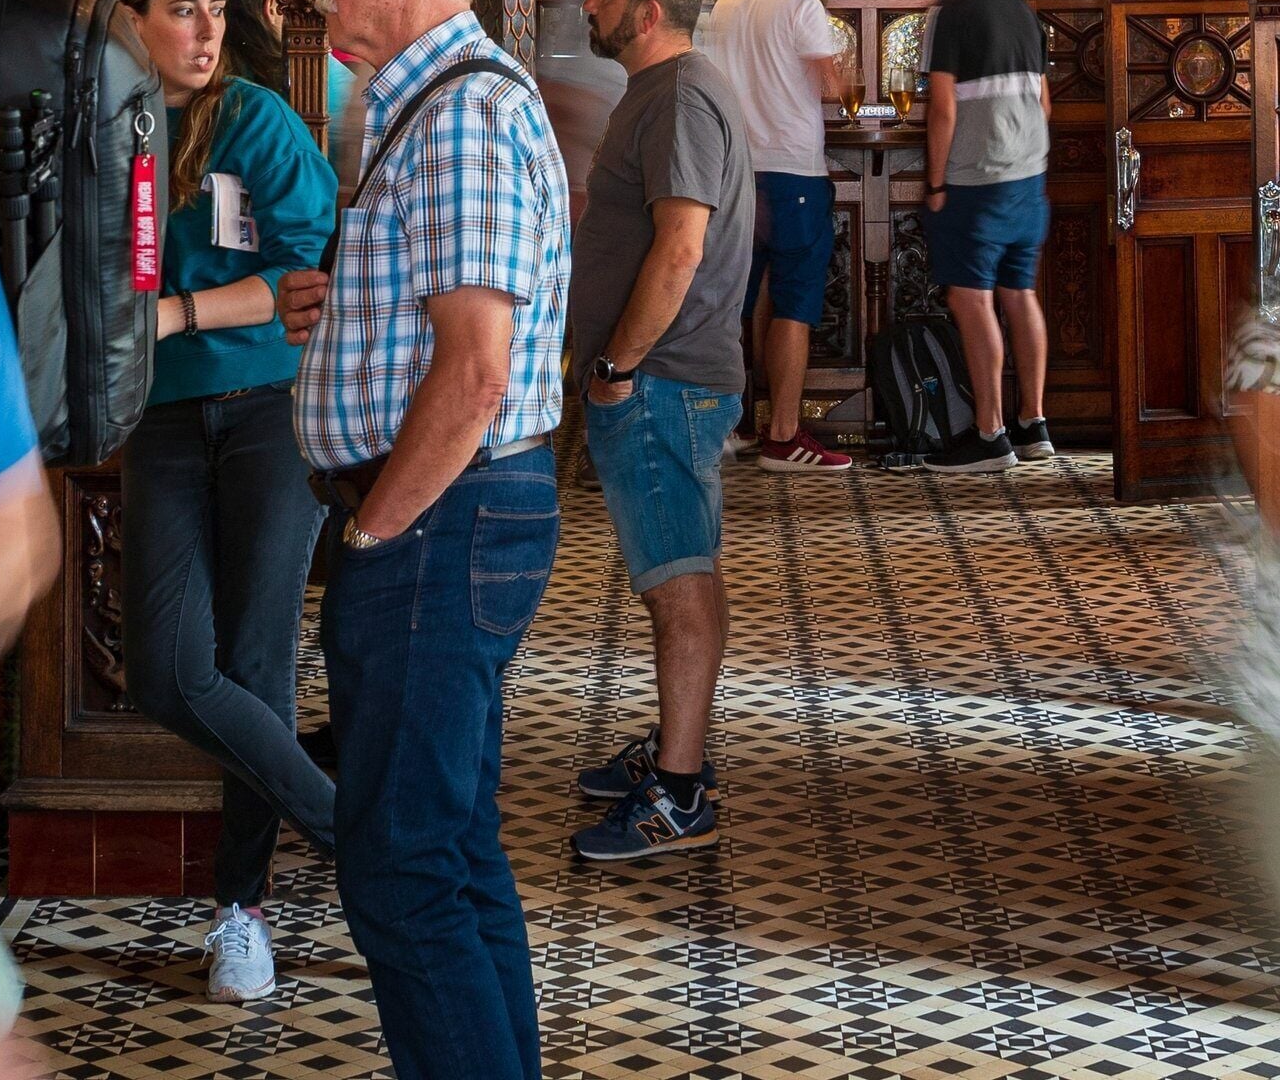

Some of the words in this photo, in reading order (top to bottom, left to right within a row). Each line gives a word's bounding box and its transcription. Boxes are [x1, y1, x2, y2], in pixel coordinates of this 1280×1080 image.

[137, 181, 153, 213] REMOVE
[136, 215, 155, 246] BEFORE
[135, 248, 157, 276] FLIGHT
[635, 813, 675, 847] N
